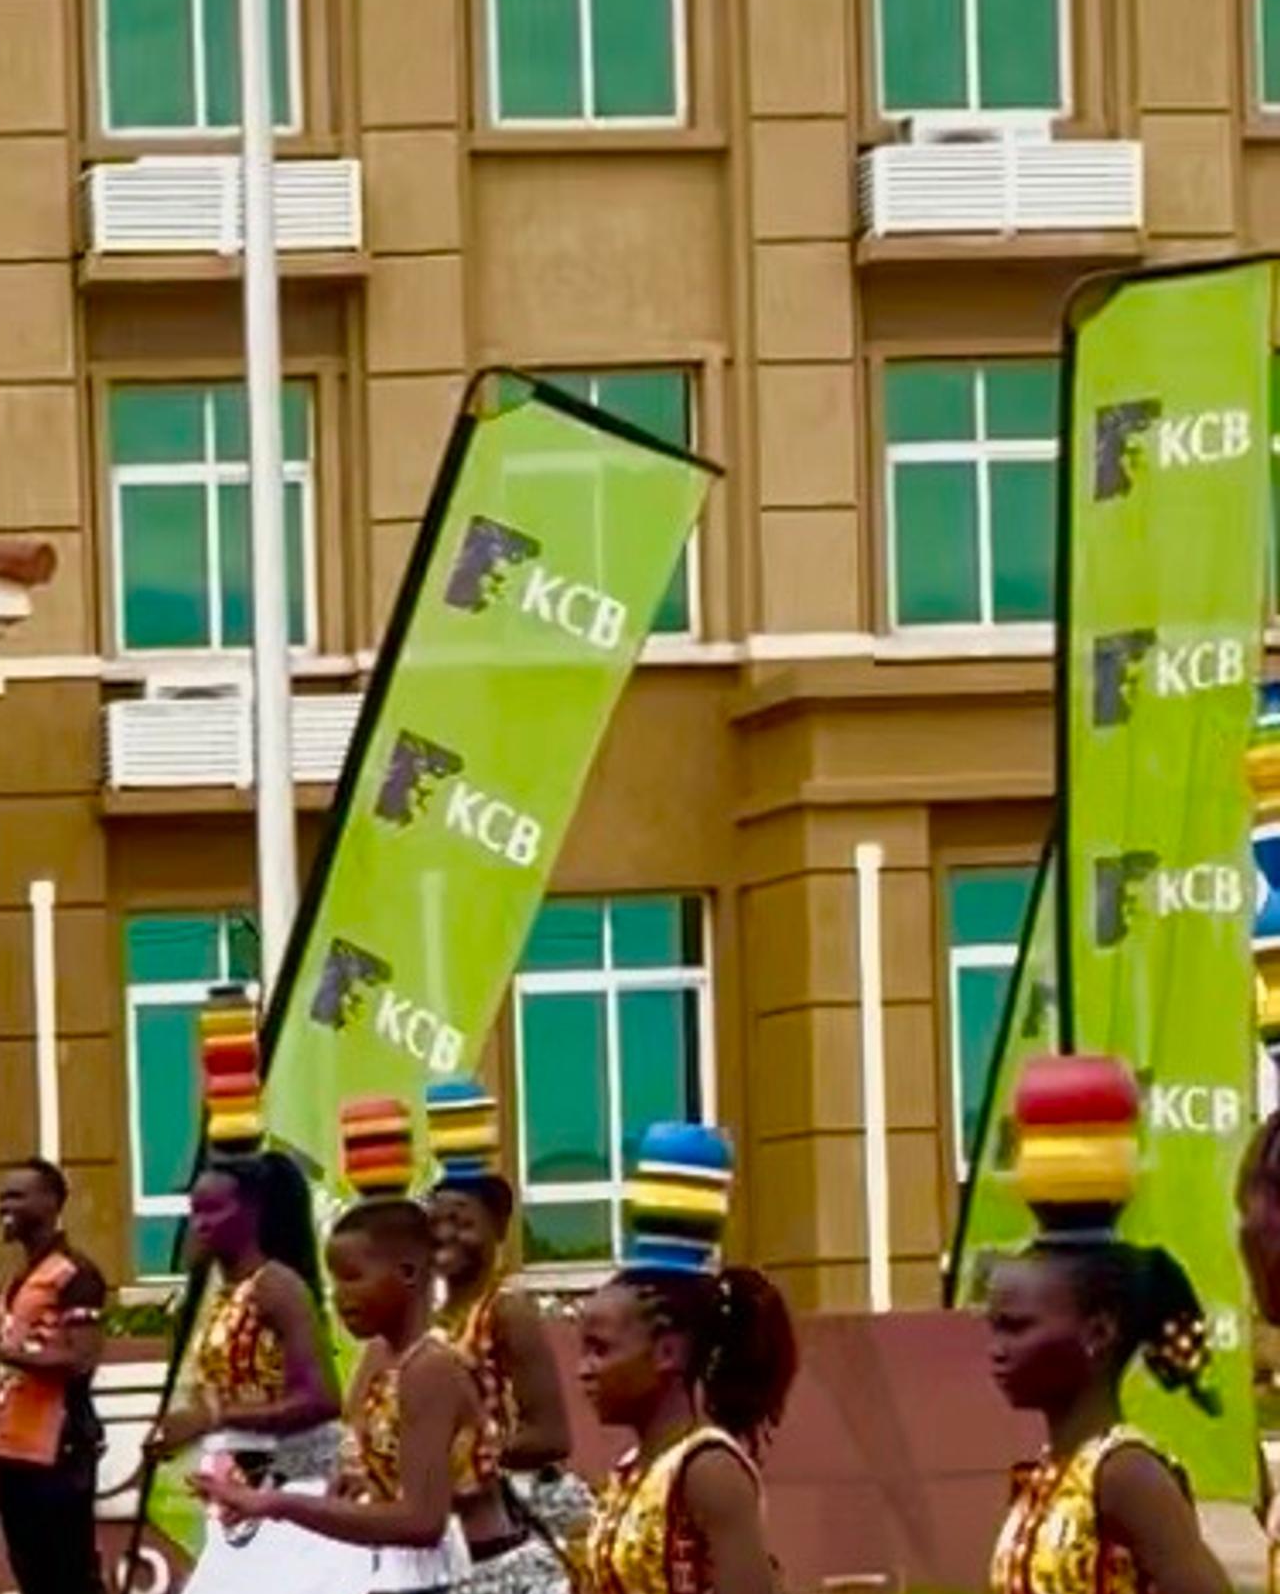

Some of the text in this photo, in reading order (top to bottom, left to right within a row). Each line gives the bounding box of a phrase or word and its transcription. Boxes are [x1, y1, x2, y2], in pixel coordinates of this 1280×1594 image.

[1158, 410, 1250, 466] KCB
[521, 566, 627, 651] KCB
[1155, 637, 1243, 694] KCB
[446, 783, 540, 865] KCB
[1157, 863, 1242, 915] KCB
[376, 991, 463, 1076] KCB
[1150, 1085, 1240, 1135] KCB
